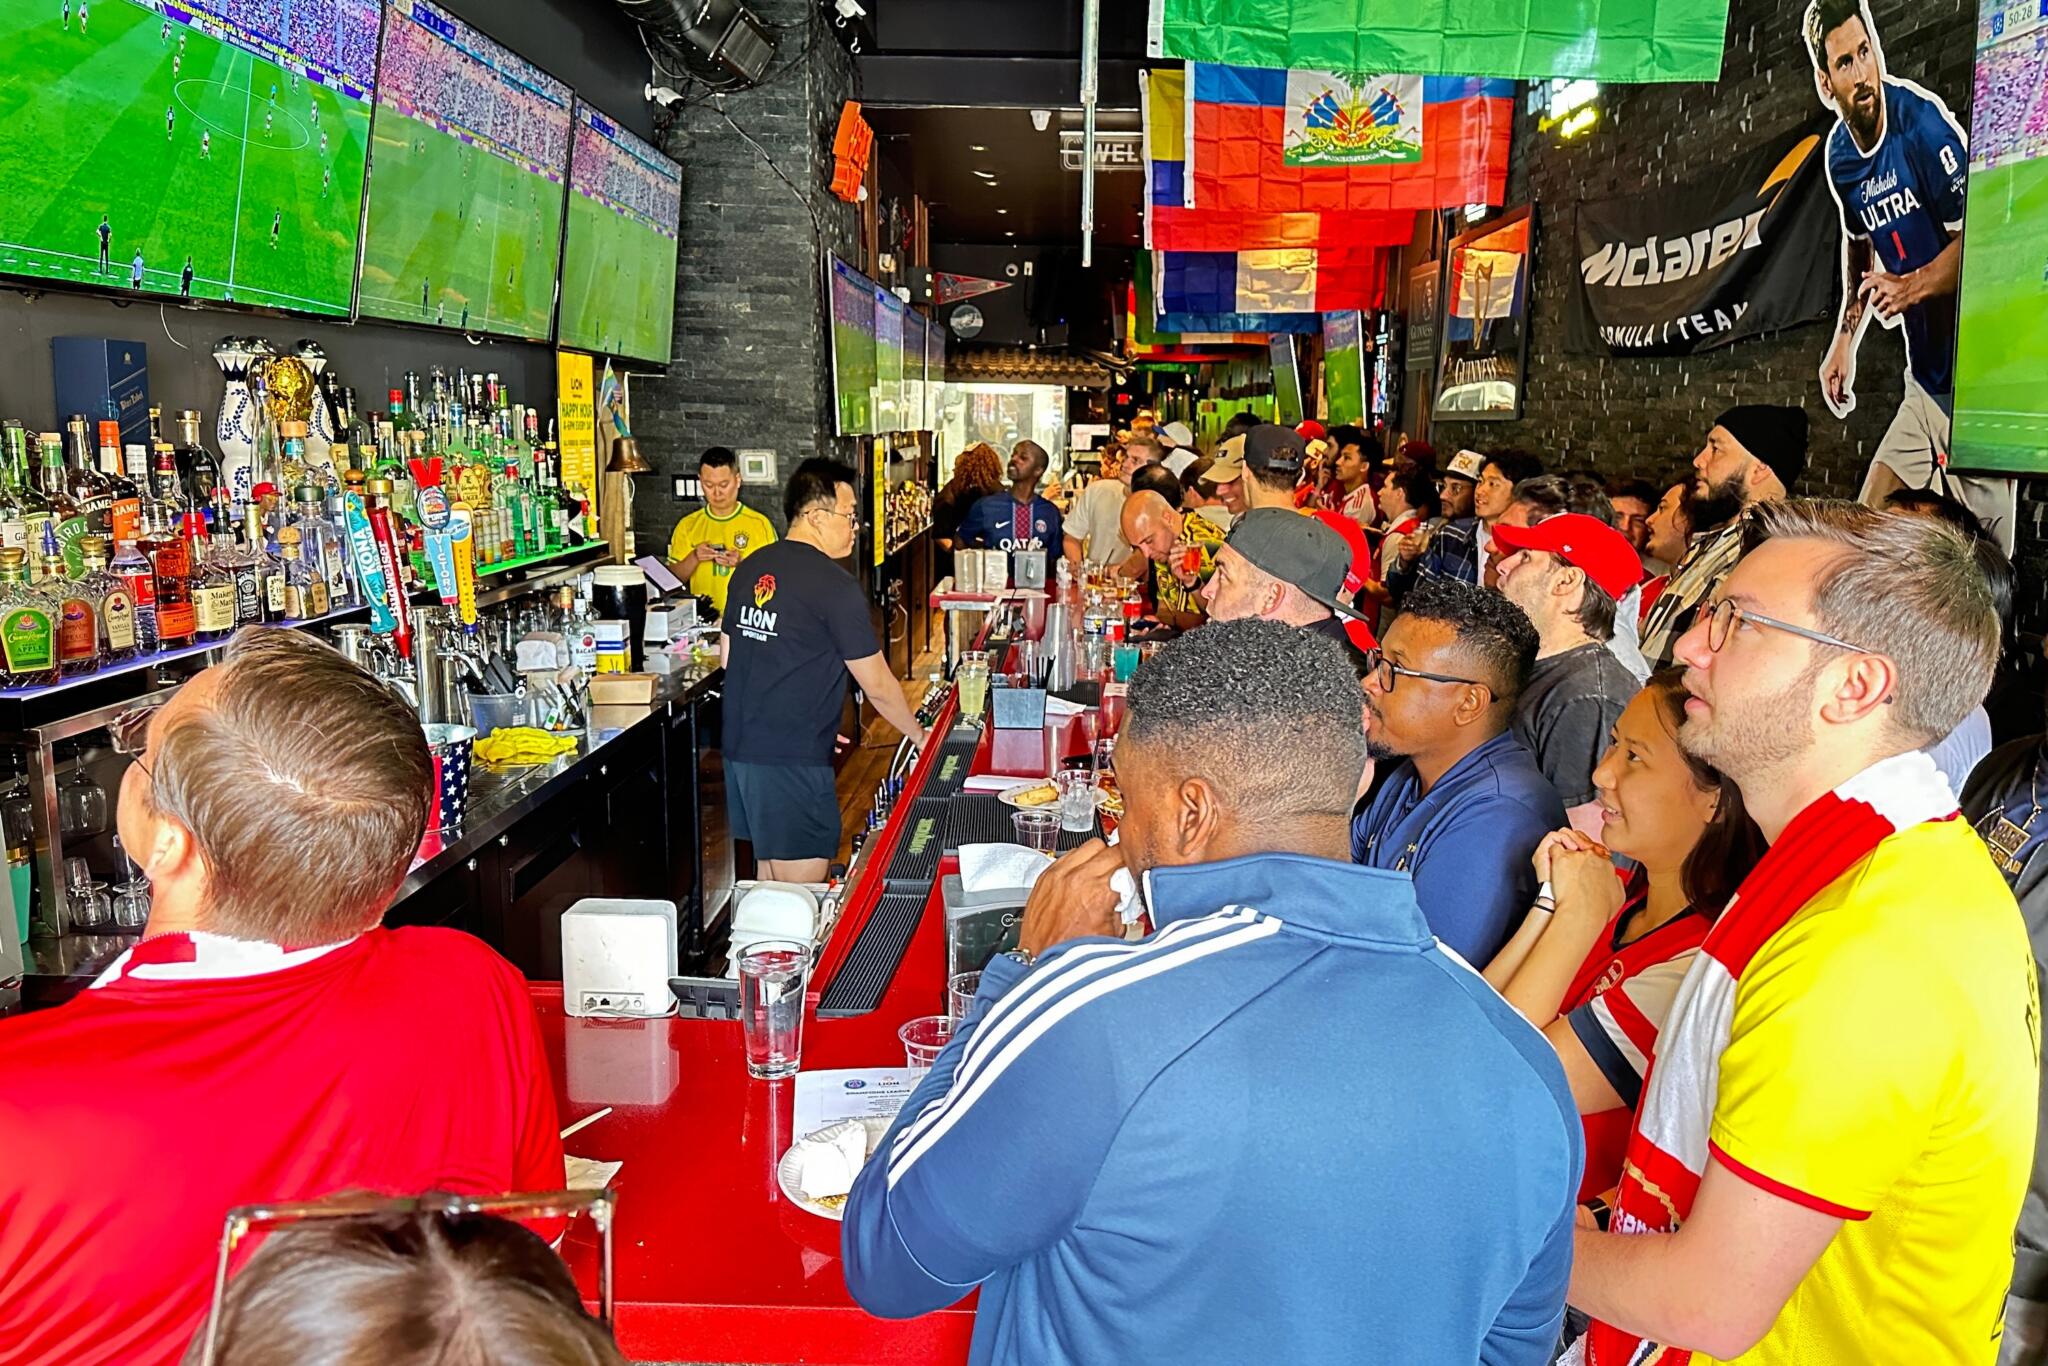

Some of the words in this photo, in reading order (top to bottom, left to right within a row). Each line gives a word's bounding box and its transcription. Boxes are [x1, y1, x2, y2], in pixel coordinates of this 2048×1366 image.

[2008, 4, 2033, 27] 50:28
[1861, 168, 1898, 204] Michelob
[1860, 187, 1920, 232] ULTRA
[1455, 356, 1498, 385] GUINNESS
[353, 528, 378, 575] KONA
[433, 536, 452, 594] VICTORY
[377, 540, 401, 616] Budweiser
[740, 605, 777, 631] LION
